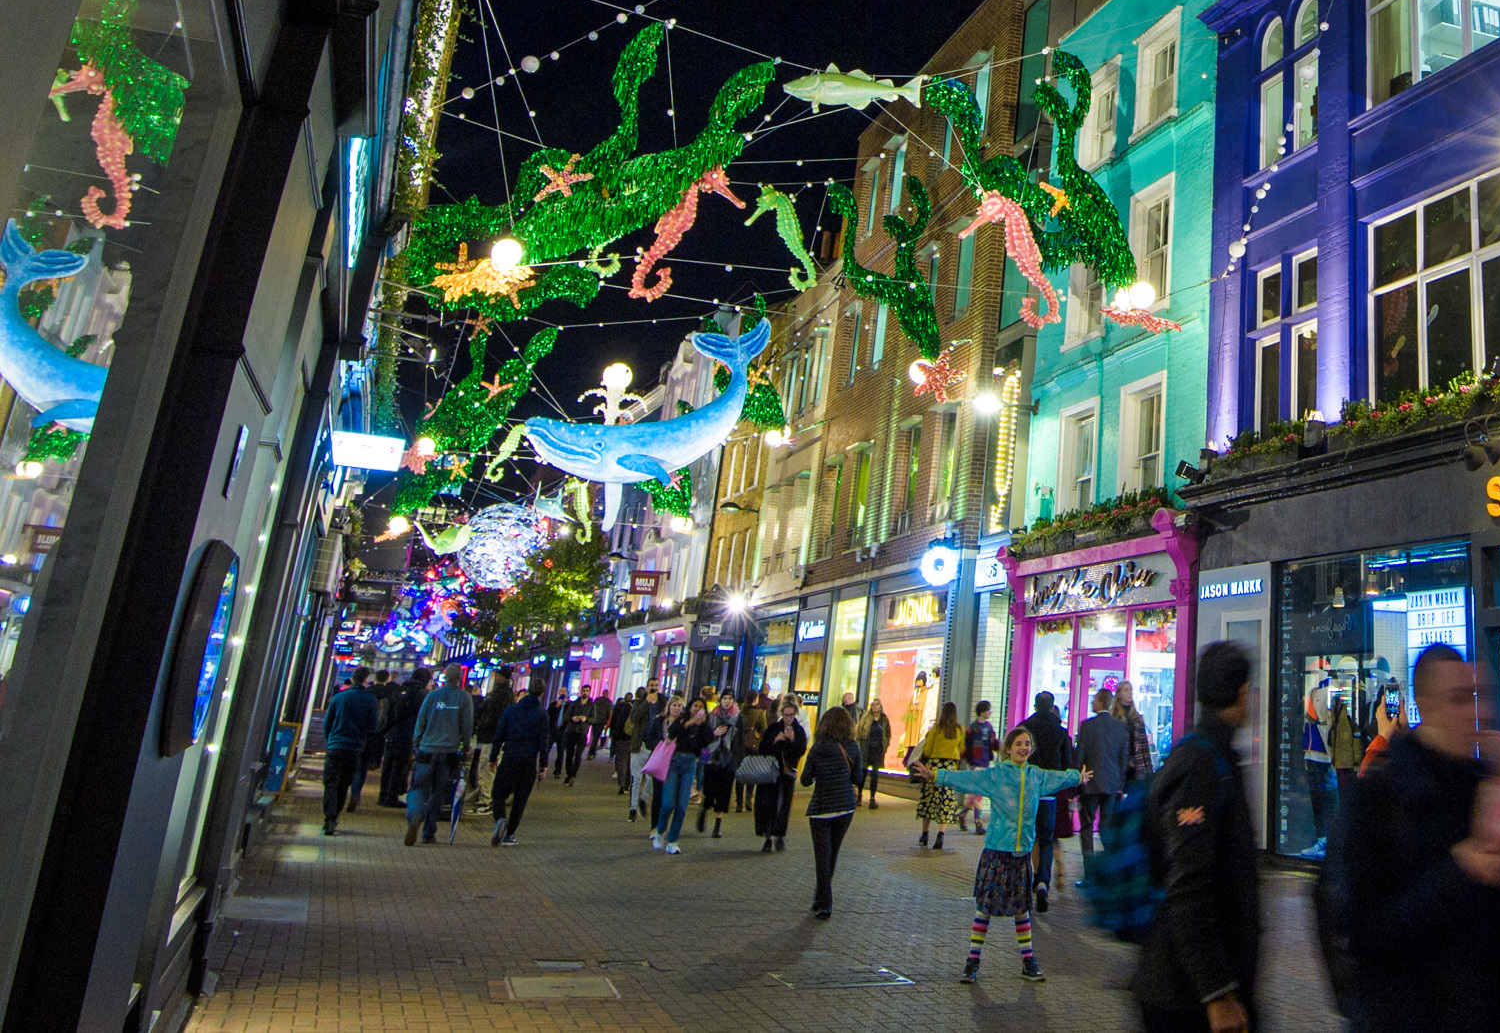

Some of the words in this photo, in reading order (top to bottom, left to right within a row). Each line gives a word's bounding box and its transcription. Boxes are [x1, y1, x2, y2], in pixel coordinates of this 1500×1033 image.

[635, 577, 655, 587] MUJI
[1200, 583, 1229, 599] JASON
[1231, 579, 1262, 595] MARKK
[1410, 593, 1433, 608] JASON
[1435, 591, 1459, 605] MARKK
[1418, 613, 1435, 626] DROP
[1442, 611, 1455, 624] OFF
[1420, 630, 1453, 645] SNEAKER
